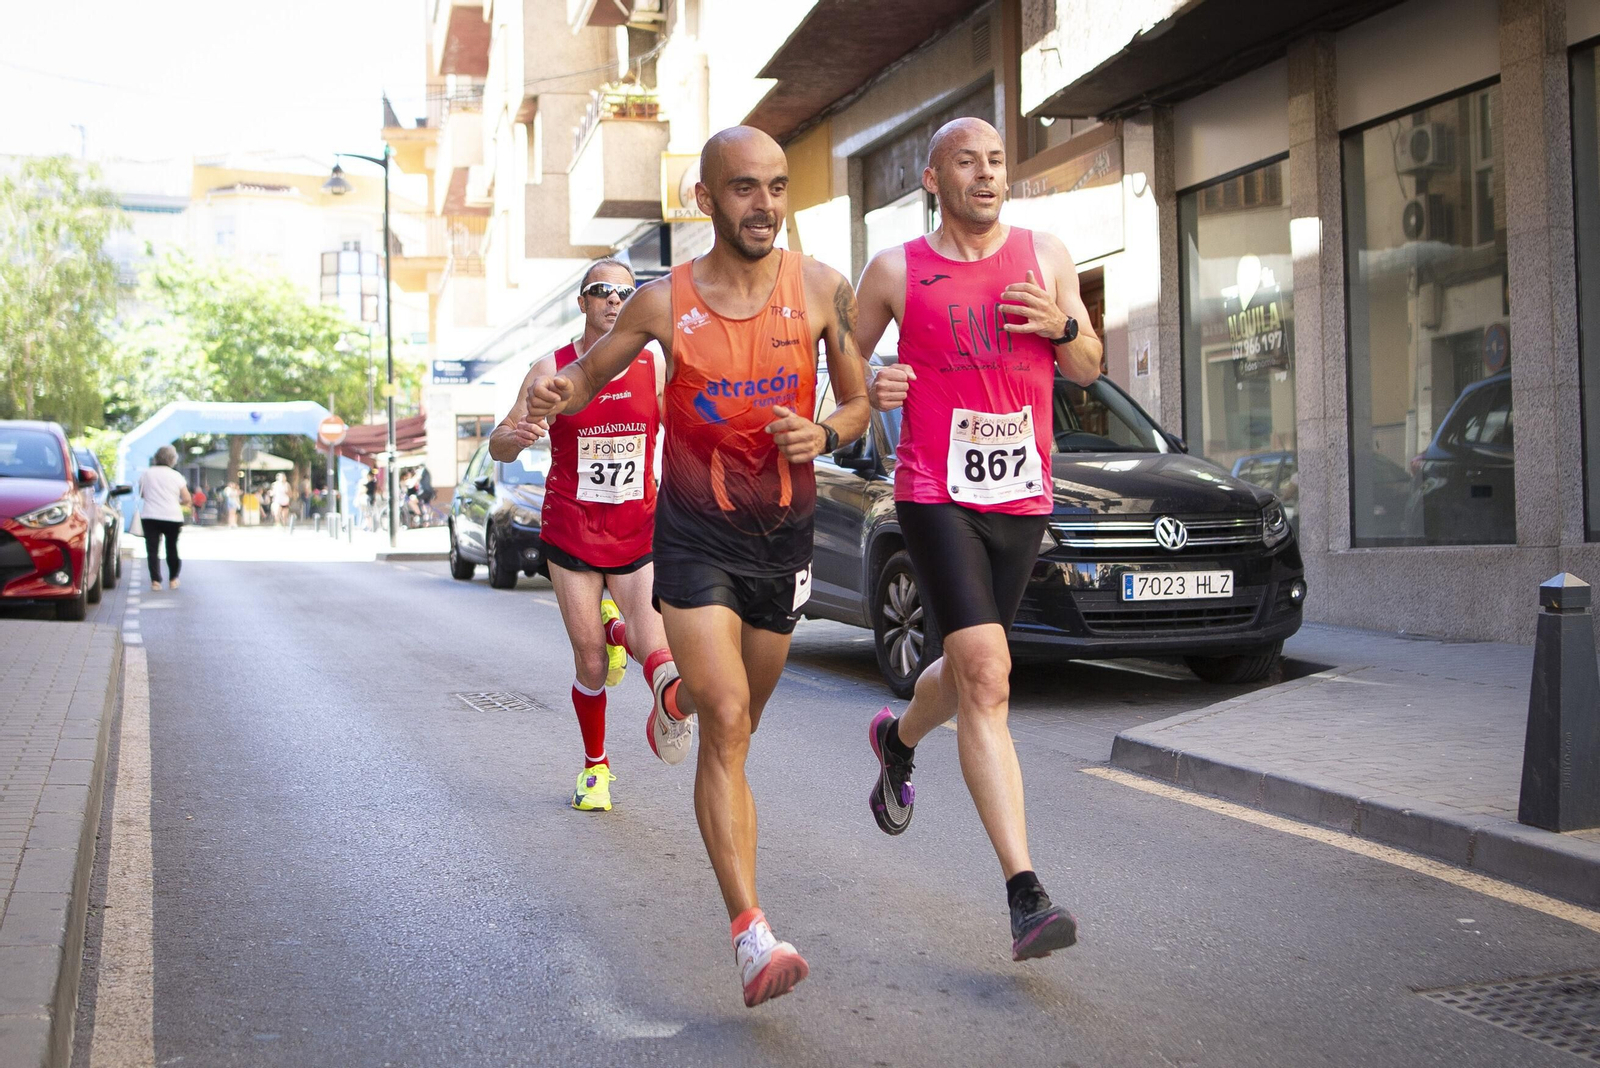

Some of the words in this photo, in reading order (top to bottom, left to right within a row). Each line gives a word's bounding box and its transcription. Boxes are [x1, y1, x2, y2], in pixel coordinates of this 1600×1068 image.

[1022, 176, 1048, 199] Bar
[770, 305, 805, 320] TRACK
[1228, 302, 1280, 340] ALQUILA
[948, 302, 1013, 357] ENA
[1243, 336, 1261, 356] 966
[1261, 330, 1282, 351] 197
[706, 366, 799, 398] atracón
[612, 390, 632, 400] rasán
[578, 422, 647, 437] WADIÁNDALUS
[595, 442, 635, 454] FONDO
[589, 461, 636, 487] 372
[964, 446, 1027, 482] 867
[1138, 577, 1186, 596] 7023
[1196, 575, 1230, 594] HLZ
